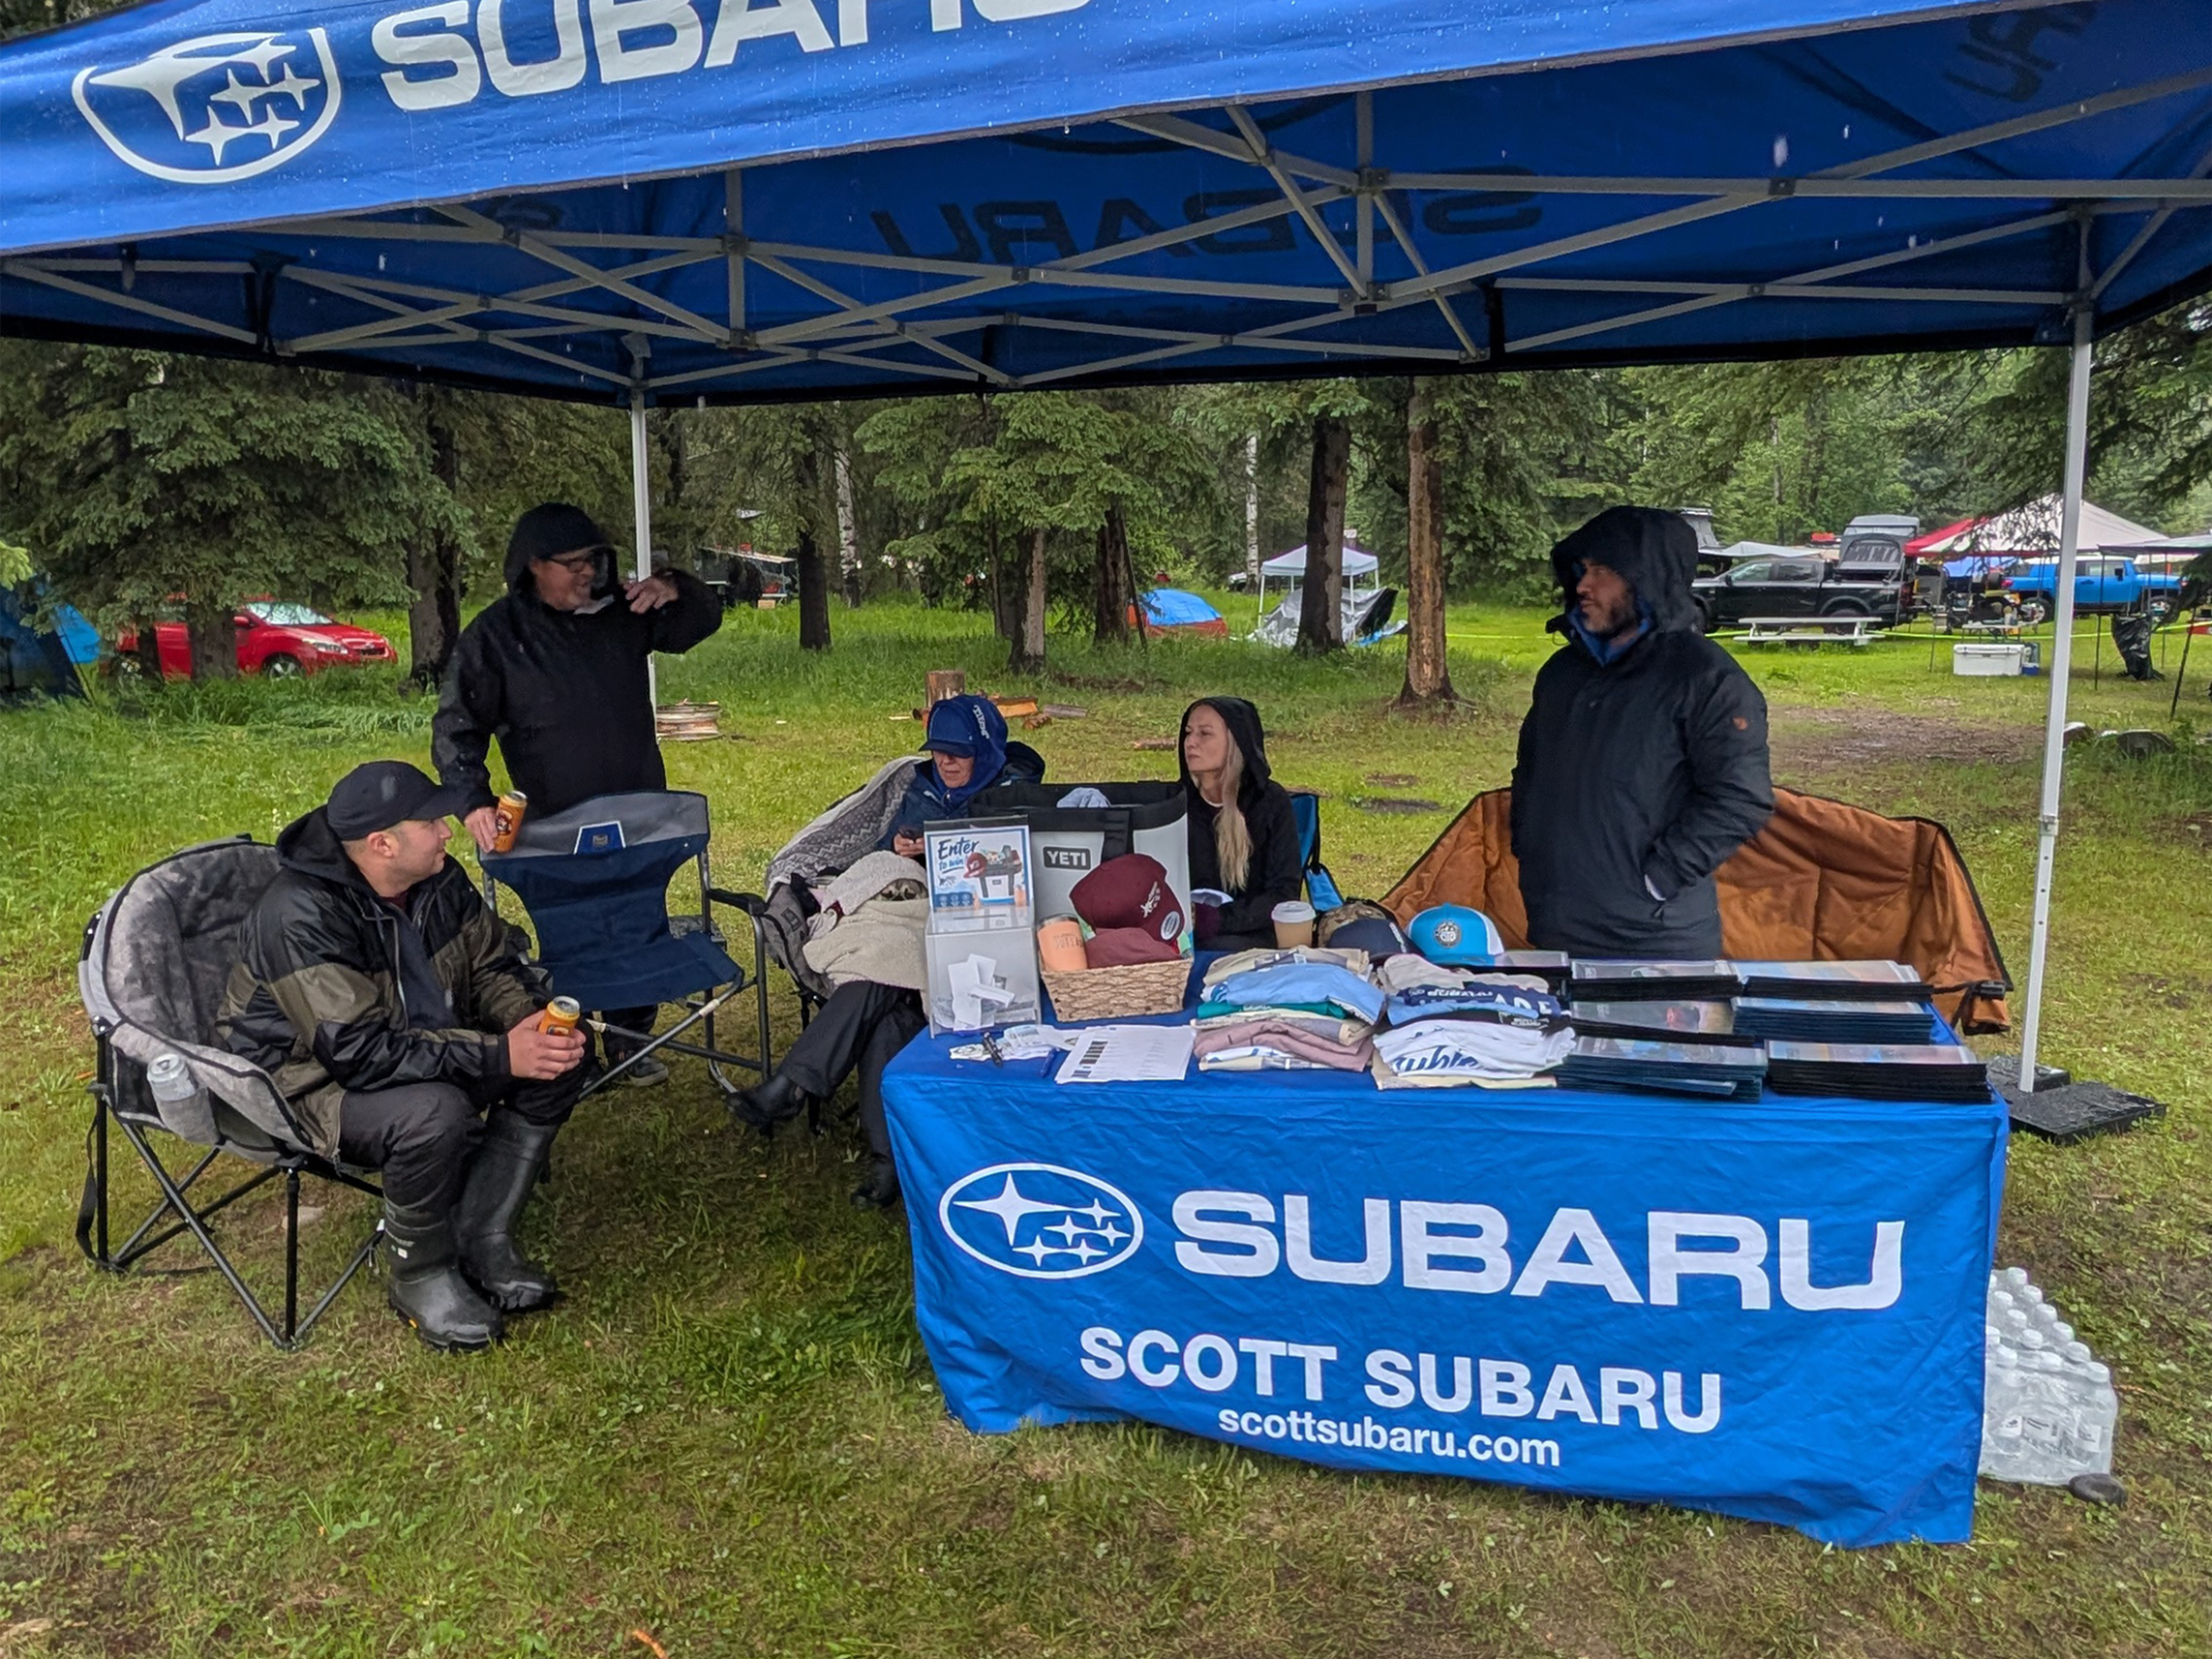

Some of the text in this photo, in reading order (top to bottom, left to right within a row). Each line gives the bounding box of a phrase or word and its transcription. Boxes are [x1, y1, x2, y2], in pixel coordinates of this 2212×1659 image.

[372, 0, 1091, 111] SUBA
[937, 836, 980, 860] Enter
[1046, 850, 1087, 866] YETI
[1172, 1191, 1905, 1312] SUBARU
[1080, 1327, 1721, 1433] SCOTT SUBARU
[1218, 1409, 1561, 1467] scottsubaru.com
